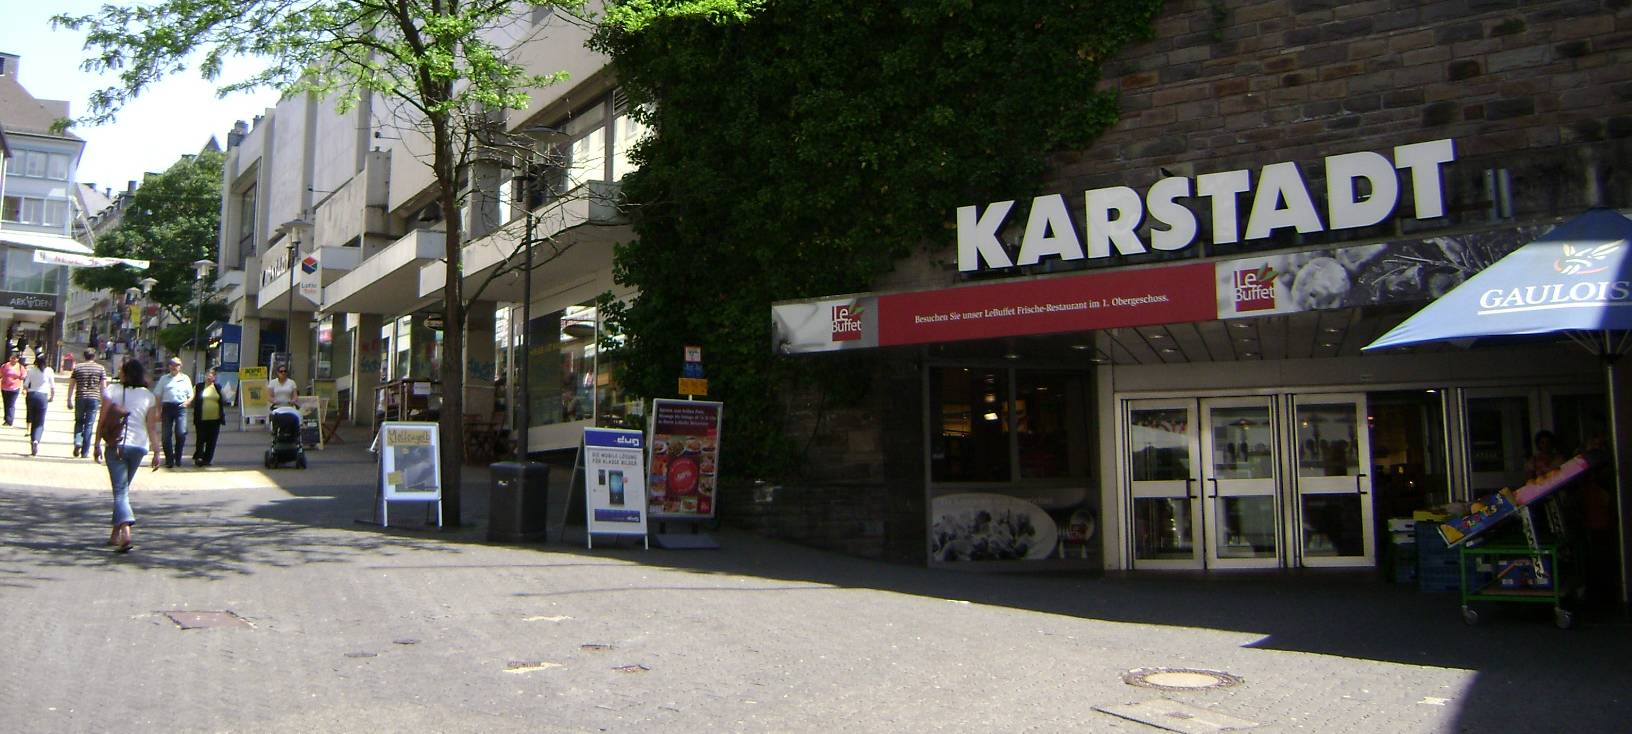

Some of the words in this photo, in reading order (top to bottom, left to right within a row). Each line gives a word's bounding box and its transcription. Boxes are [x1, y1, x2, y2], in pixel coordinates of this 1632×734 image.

[957, 138, 1456, 272] KARSTADT
[1237, 271, 1257, 288] Le
[1235, 285, 1275, 302] Buffet
[1479, 281, 1630, 309] GAULOIS
[834, 305, 849, 321] Le
[915, 314, 948, 324] Besuchen
[950, 312, 960, 321] Sie
[962, 311, 983, 320] unser
[984, 307, 1015, 318] LeBuffet
[1017, 301, 1087, 314] Frische-Restaurant
[1089, 300, 1100, 309] im
[1102, 298, 1110, 307] 1.
[1111, 294, 1169, 307] Obergeschoss.
[832, 319, 862, 333] Buffet
